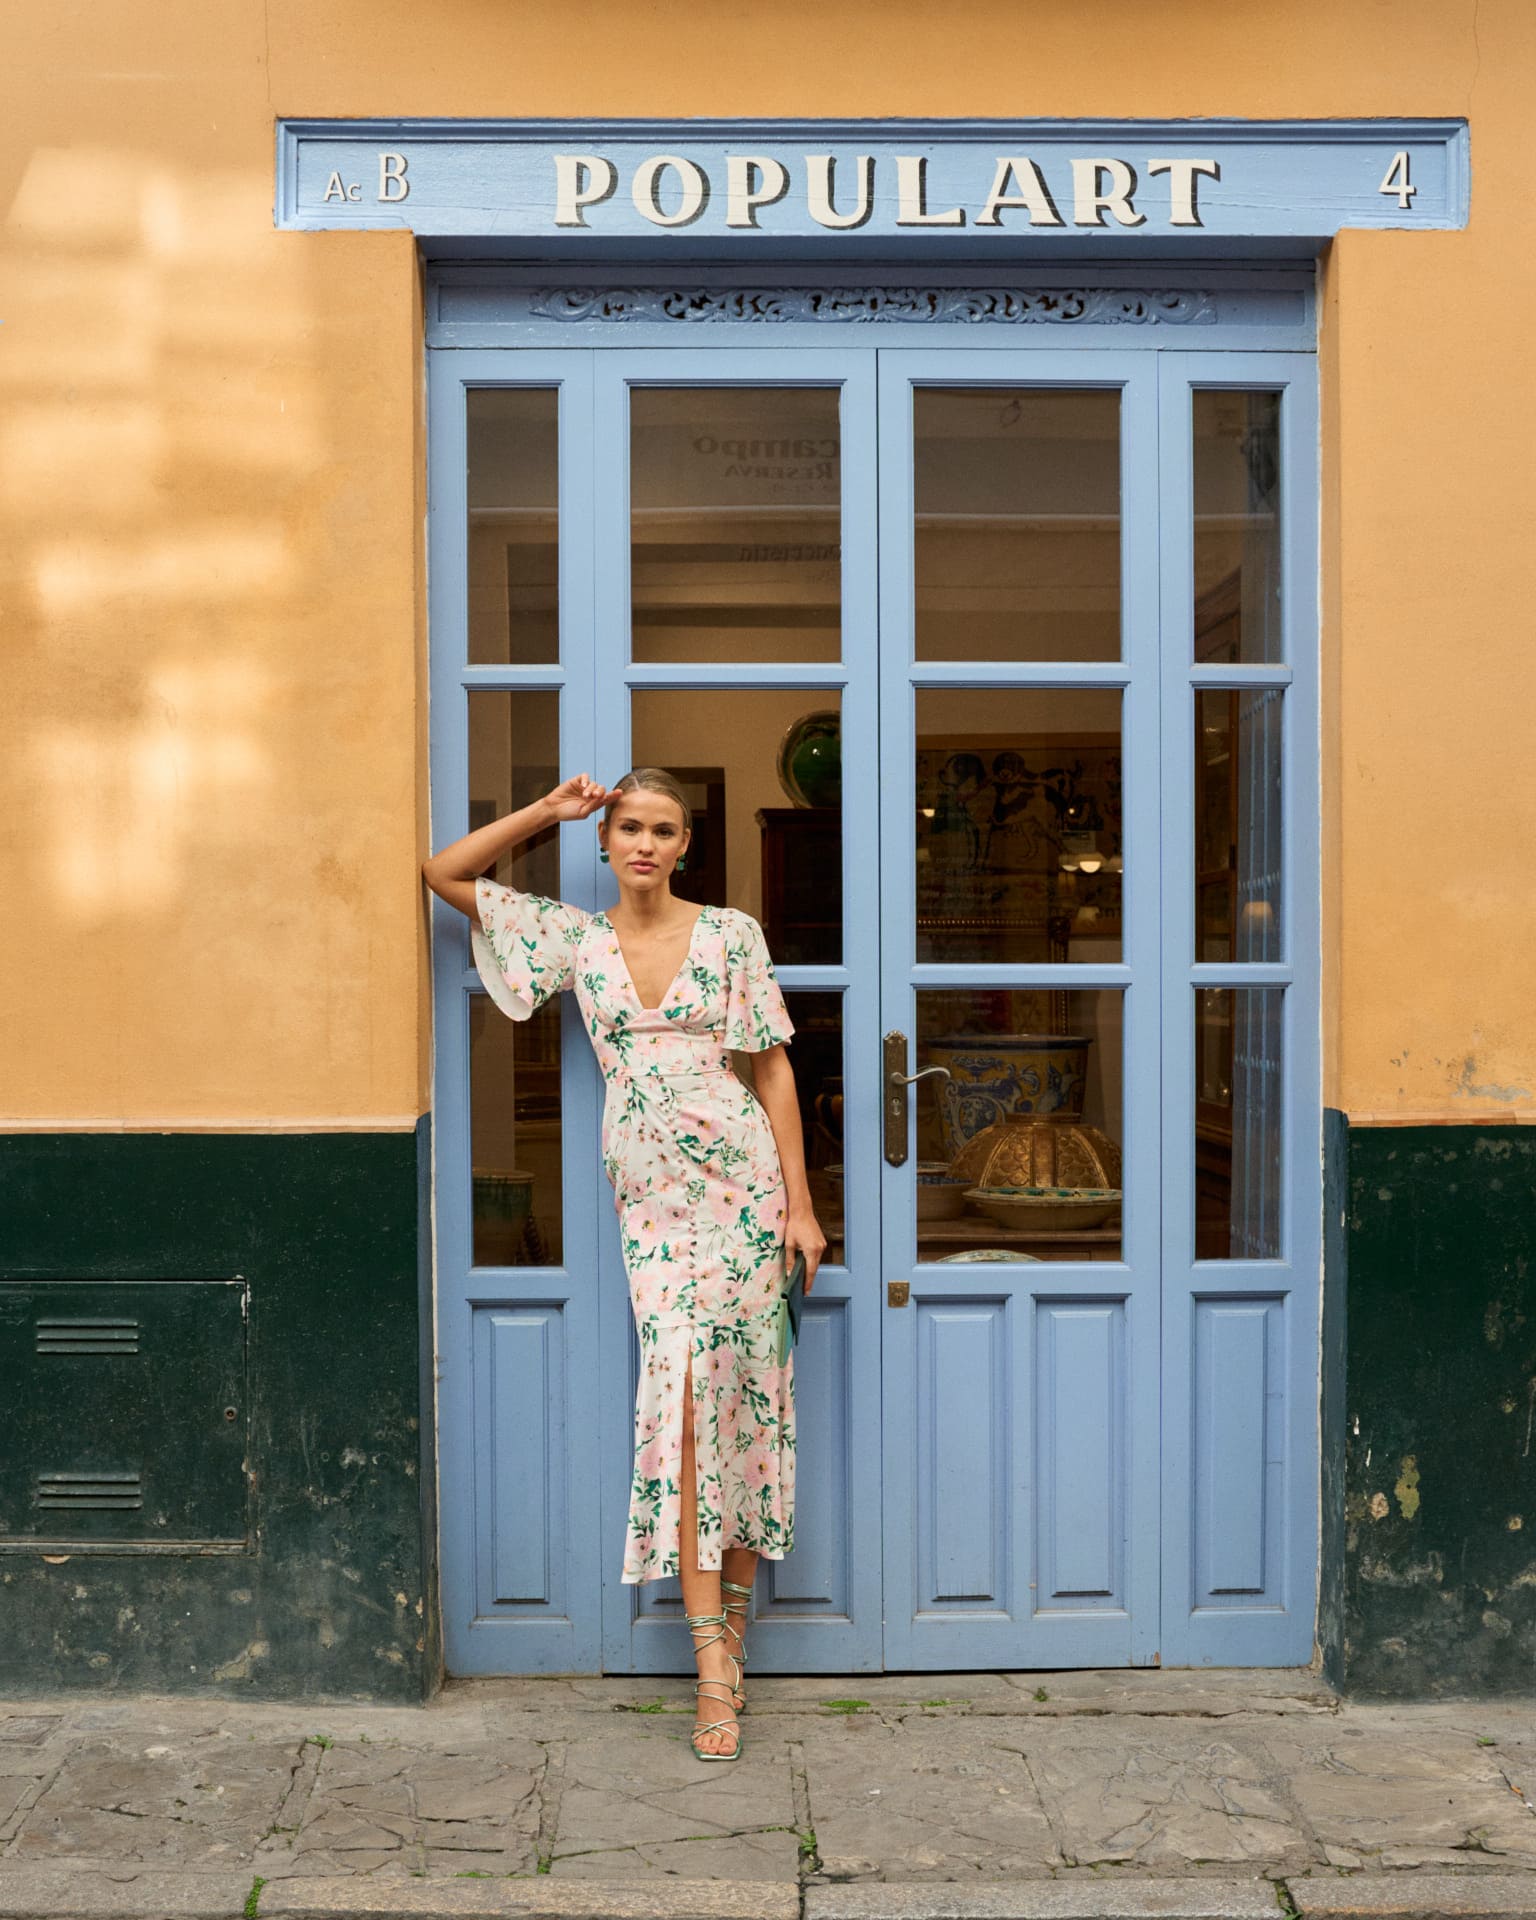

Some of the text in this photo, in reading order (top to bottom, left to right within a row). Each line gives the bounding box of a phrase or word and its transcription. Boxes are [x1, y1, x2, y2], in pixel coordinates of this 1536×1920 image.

[377, 152, 410, 202] B
[553, 154, 1220, 228] POPULART
[1378, 151, 1417, 209] 4
